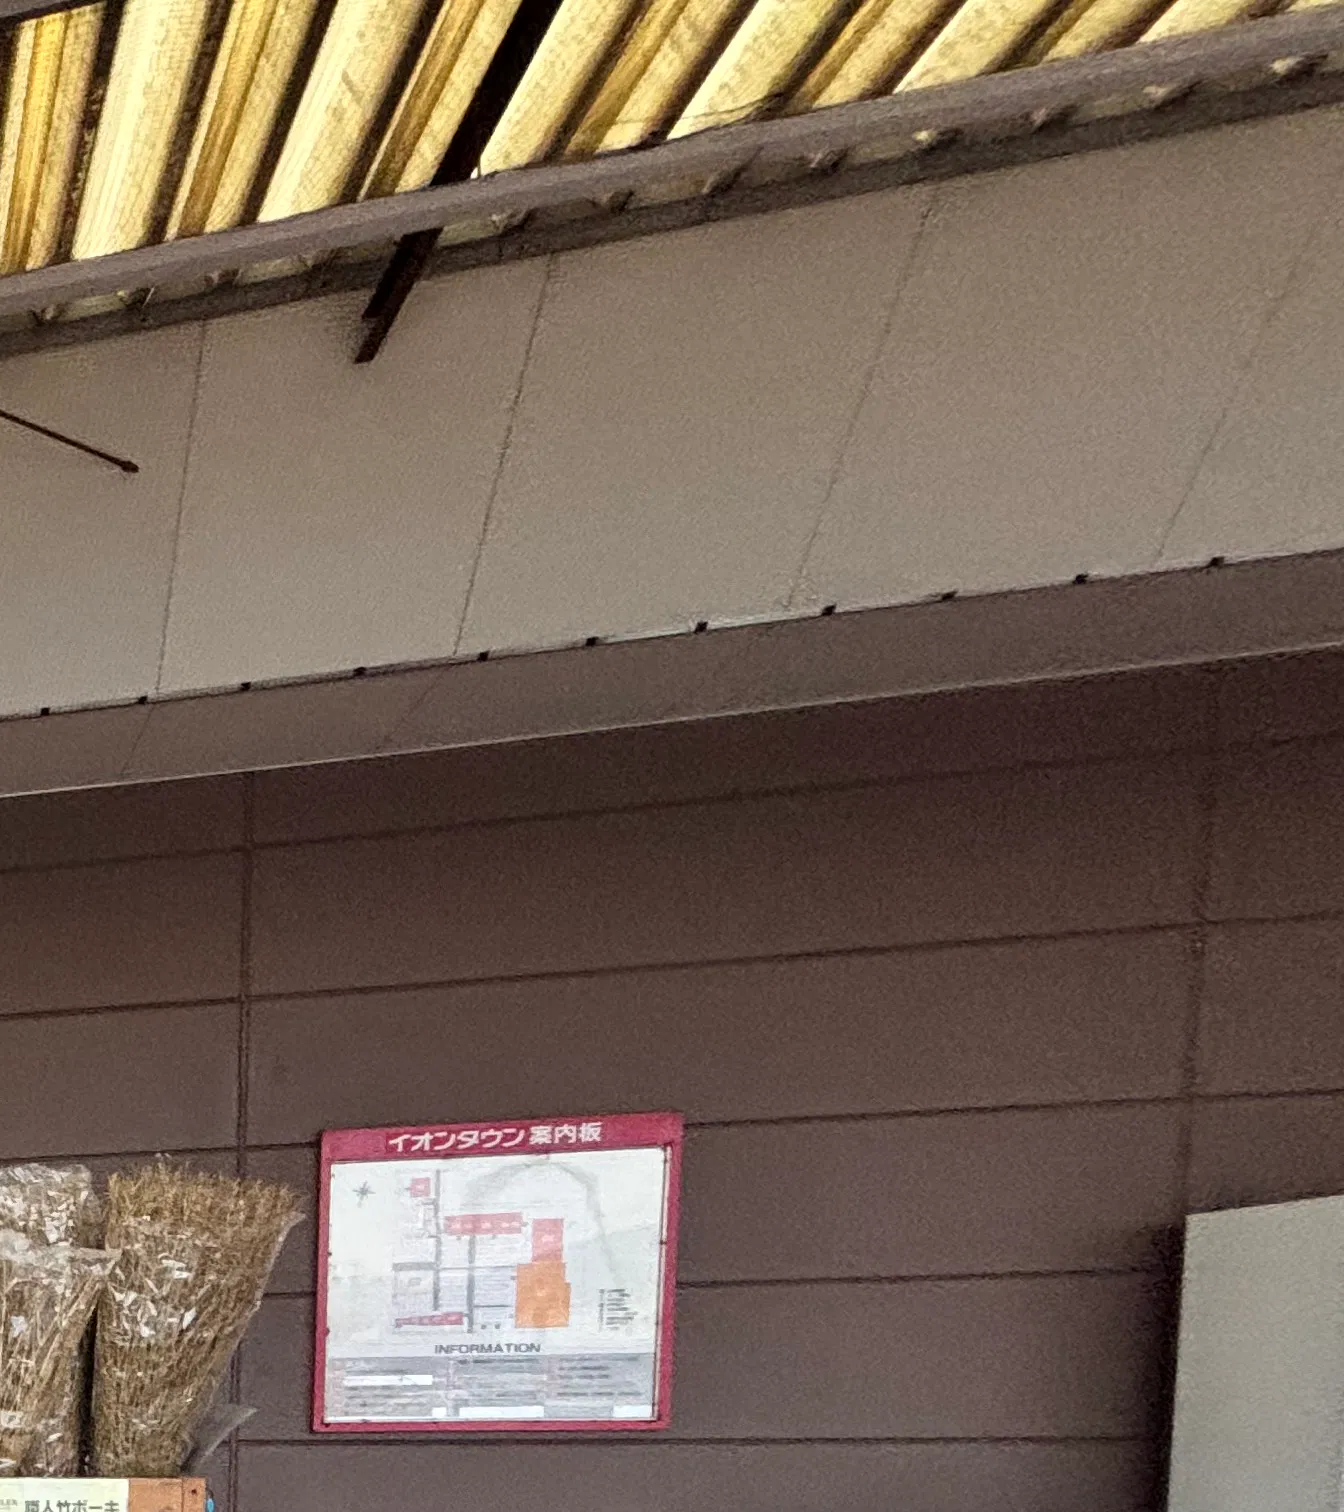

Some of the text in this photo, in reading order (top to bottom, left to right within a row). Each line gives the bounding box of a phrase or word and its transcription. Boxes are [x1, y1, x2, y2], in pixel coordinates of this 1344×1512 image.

[529, 1121, 604, 1145] 案内板
[434, 1342, 542, 1355] INFORMATION
